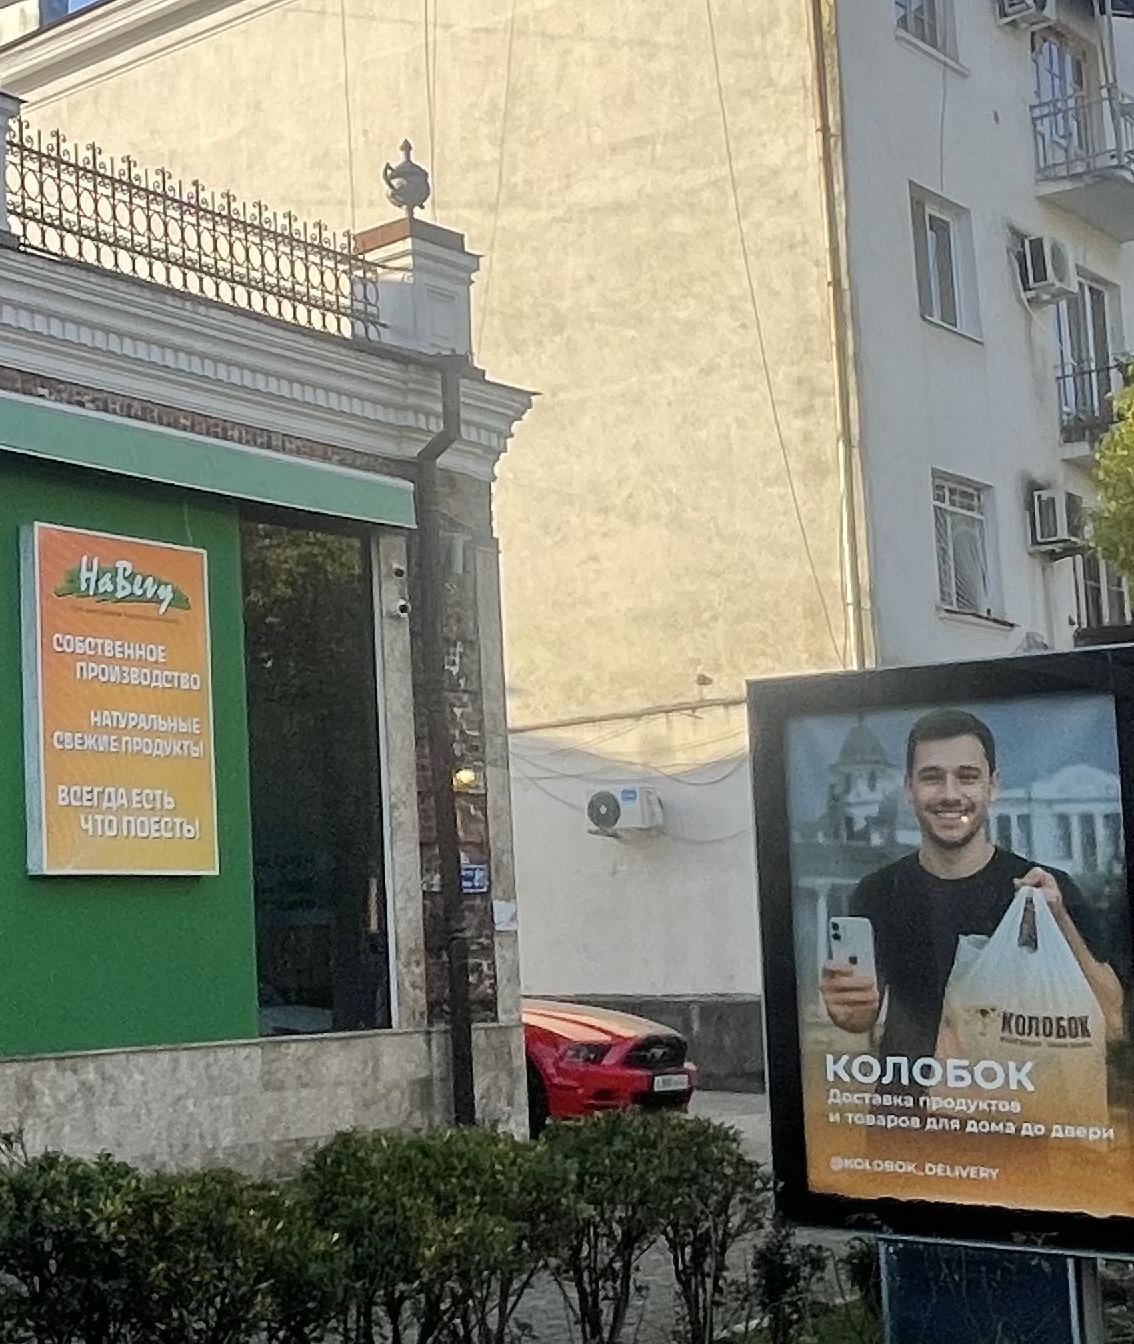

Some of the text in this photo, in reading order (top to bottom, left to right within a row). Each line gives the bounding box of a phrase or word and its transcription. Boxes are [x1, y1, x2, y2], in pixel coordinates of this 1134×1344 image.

[52, 632, 167, 663] СОБСТВЕННОЕ
[76, 661, 201, 691] ПРОИЗВОДСТВО
[90, 709, 202, 735] НАТУРАЛЬНЫЕ
[52, 729, 204, 758] СВЕЖИЕ ПРОДУКТЫ
[57, 784, 176, 811] ВСЕГДА ЕСТЬ
[79, 813, 118, 837] ЧТО
[1000, 1008, 1092, 1040] КОЛОБОК
[825, 1053, 1036, 1093] КОЛОБОК
[827, 1087, 1022, 1115] Доставка продуктов
[828, 1112, 1115, 1141] и товаров для дома до двери
[829, 1156, 1001, 1181] @KOLOBOK_DELIVERY
